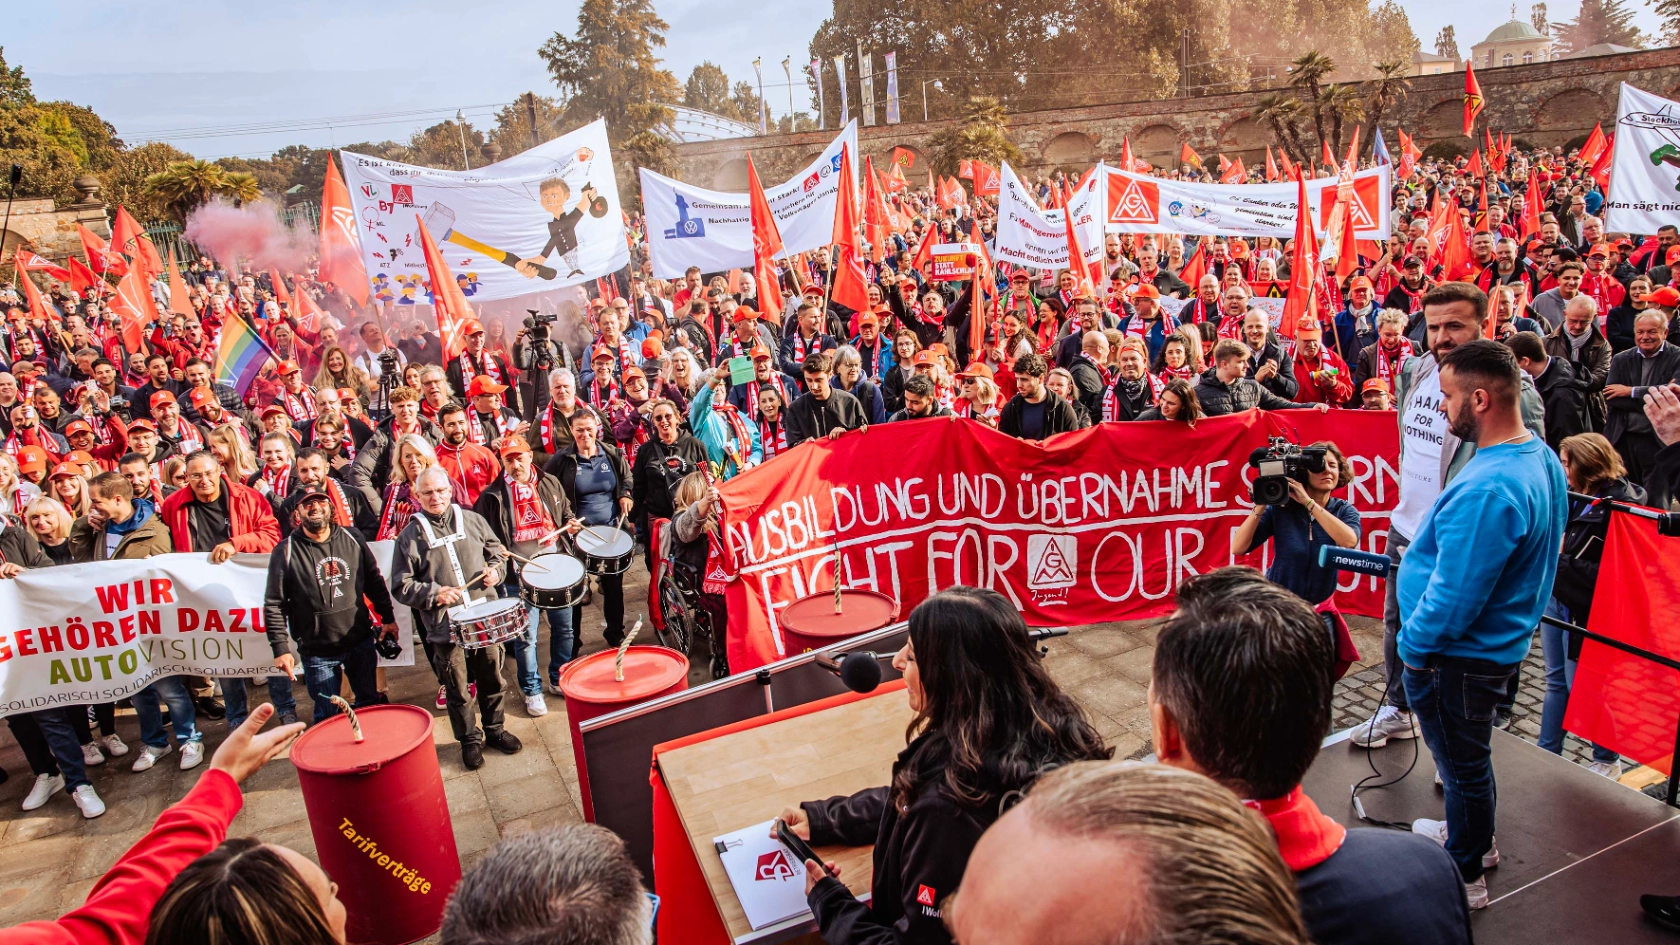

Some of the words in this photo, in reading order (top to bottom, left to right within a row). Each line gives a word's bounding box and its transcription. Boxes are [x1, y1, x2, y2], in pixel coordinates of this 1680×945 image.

[691, 201, 742, 209] Gemeinsam
[1234, 206, 1274, 218] gemeinsam
[1606, 201, 1630, 209] Man
[1633, 200, 1660, 212] sägt
[933, 254, 964, 263] ZUKUNFT
[1000, 246, 1026, 260] Macht
[1026, 254, 1054, 264] endlich
[934, 261, 955, 269] STATT
[1413, 413, 1433, 428] FOR
[726, 477, 931, 570] AUSBILDUNG
[938, 471, 1006, 519] UND
[1016, 459, 1229, 524] ÜBERNAHME
[928, 529, 1025, 612] FOR
[1090, 527, 1205, 602] OUR
[95, 577, 174, 615] WIR
[0, 610, 162, 663] GEHÖREN
[177, 607, 267, 633] DAZU
[0, 691, 100, 714] SOLIDARISCH
[102, 665, 192, 699] SOLIDARISCH
[194, 665, 285, 676] SOLIDARISC
[338, 817, 432, 895] Tarifverträge
